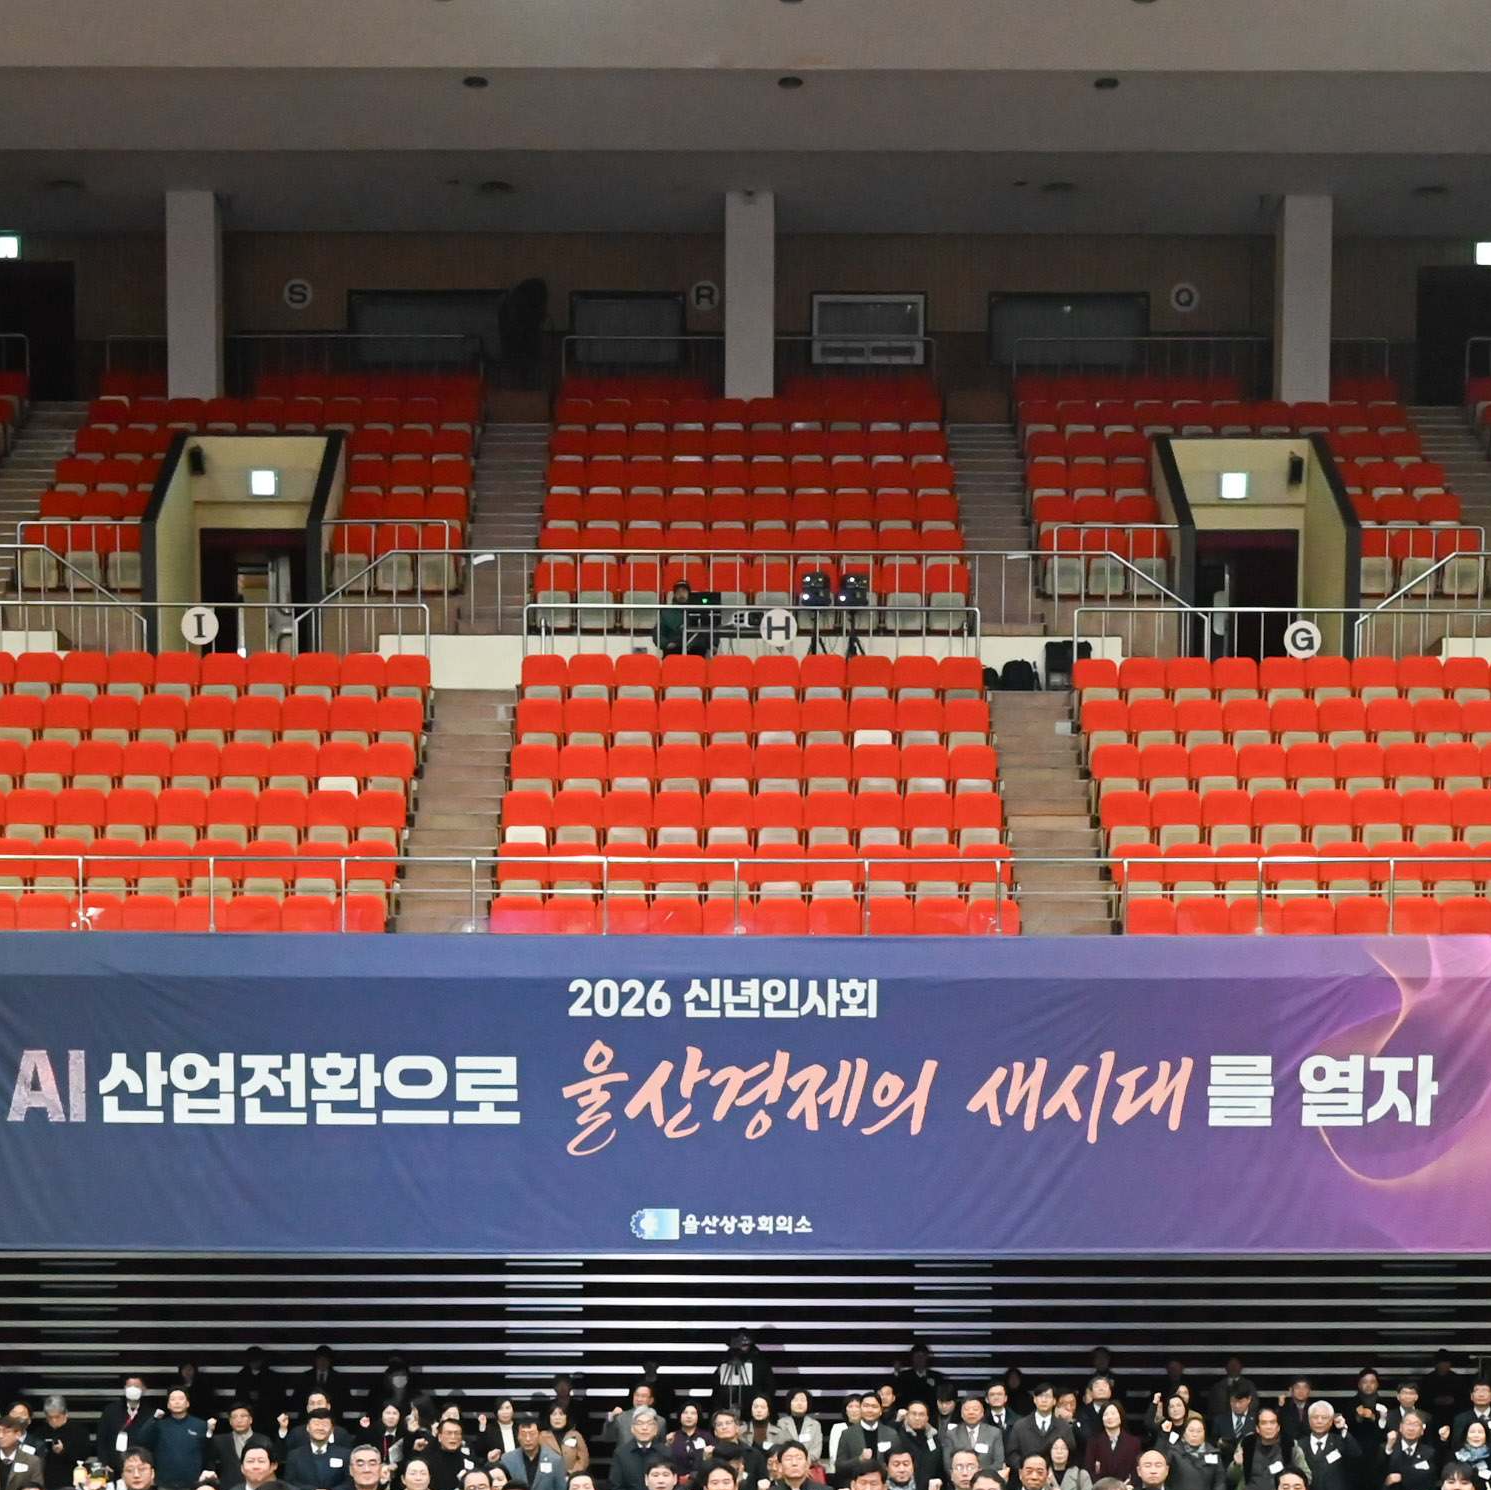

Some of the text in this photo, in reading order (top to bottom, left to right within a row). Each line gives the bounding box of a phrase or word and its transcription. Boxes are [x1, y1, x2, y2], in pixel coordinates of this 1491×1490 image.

[289, 284, 307, 303] S
[696, 286, 715, 305] R
[194, 614, 207, 639] I
[767, 616, 790, 640] H
[1291, 627, 1314, 652] G
[567, 977, 879, 1019] 2026 신년인사회
[6, 1049, 521, 1125] AI산업전환으로
[562, 1039, 939, 1156] 울산경제의
[1299, 1054, 1439, 1127] 열자
[682, 1213, 813, 1235] 울산상공회의소
